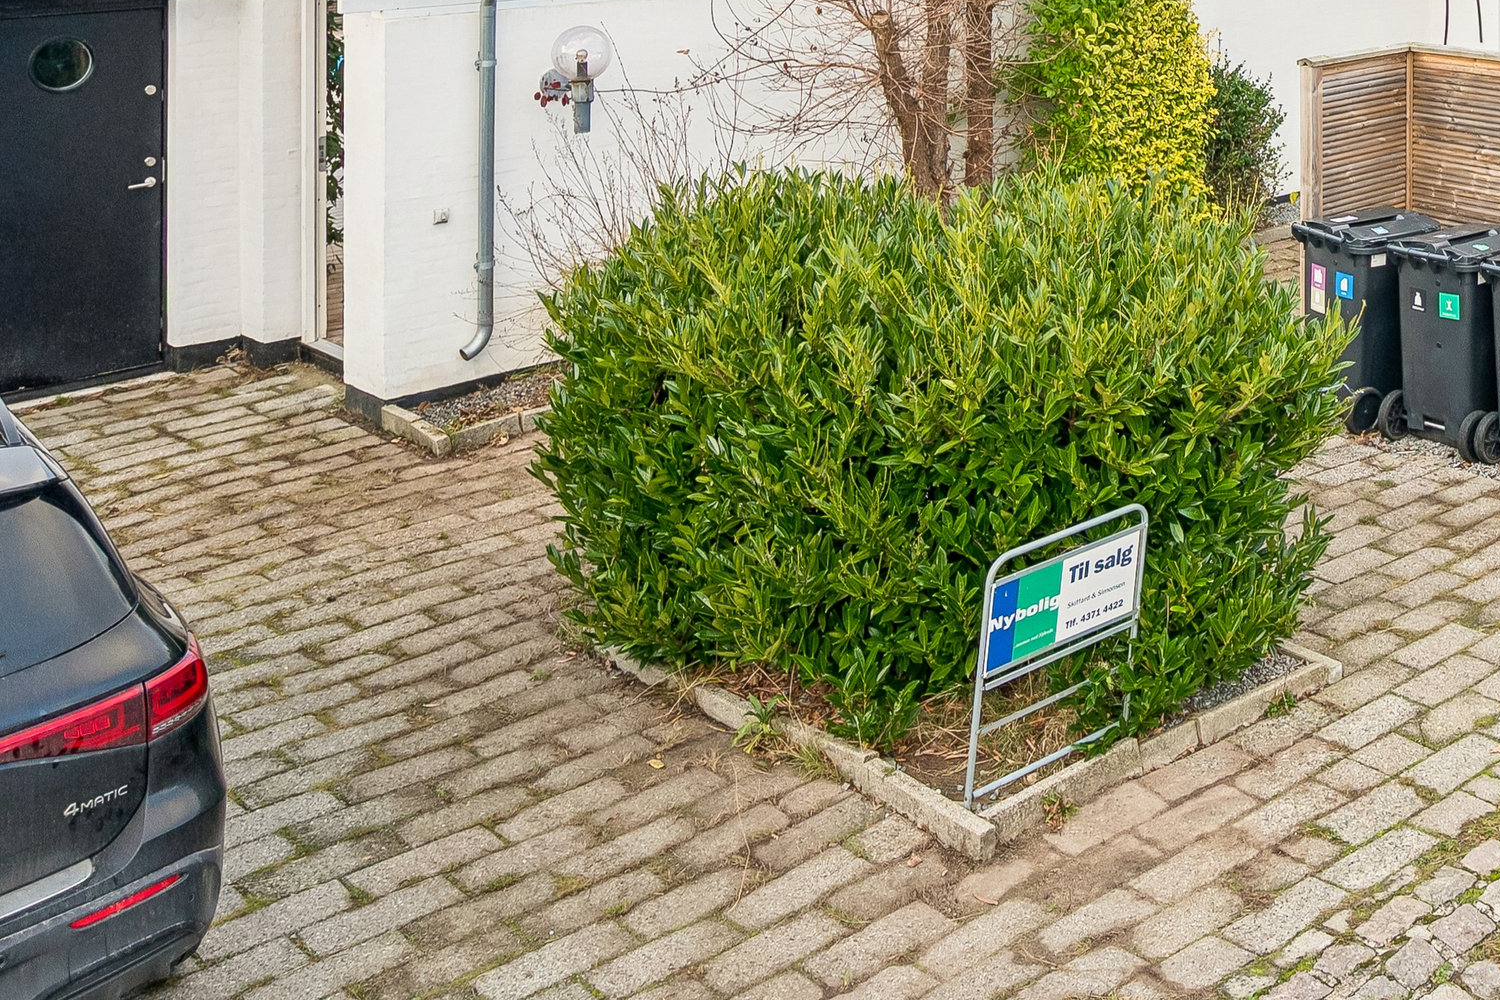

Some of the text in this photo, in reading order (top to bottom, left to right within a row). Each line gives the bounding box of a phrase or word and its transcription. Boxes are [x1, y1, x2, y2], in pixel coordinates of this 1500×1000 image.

[1069, 544, 1134, 584] Til salg
[1090, 592, 1097, 600] &
[989, 593, 1061, 633] Nybolig
[1065, 598, 1124, 630] Tlf. 4371 4422
[63, 784, 129, 817] 4MATIC
